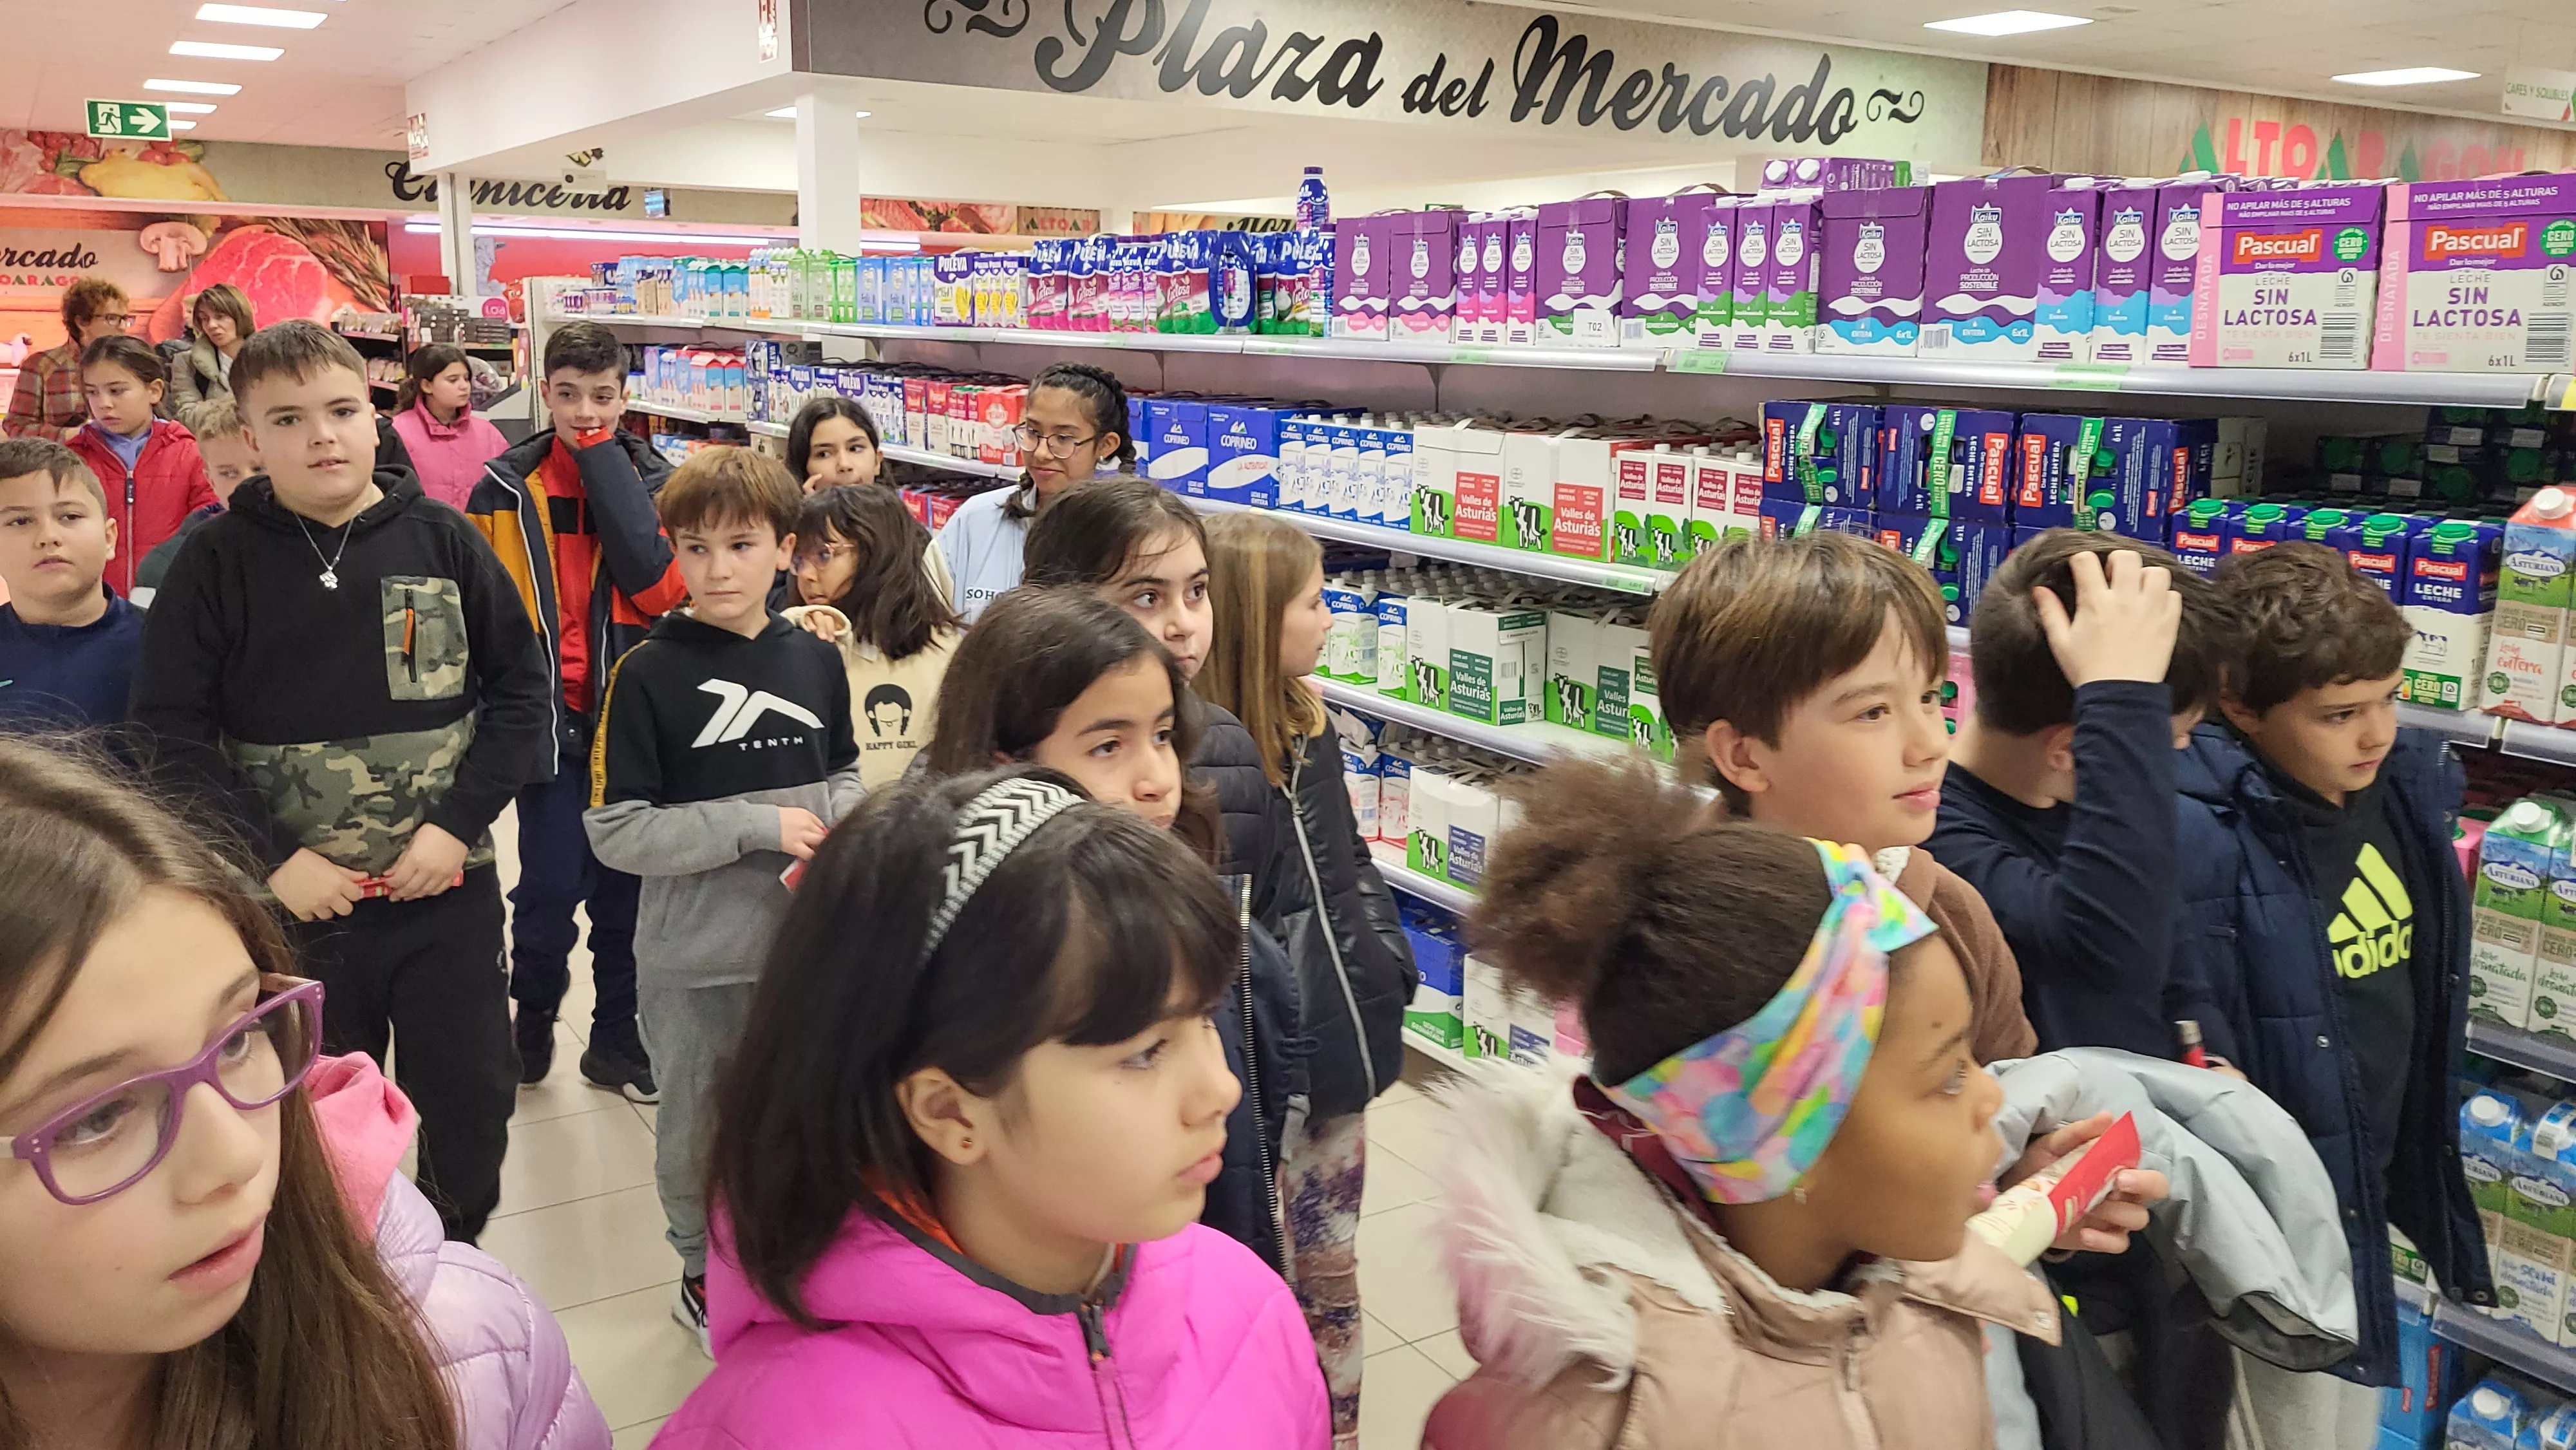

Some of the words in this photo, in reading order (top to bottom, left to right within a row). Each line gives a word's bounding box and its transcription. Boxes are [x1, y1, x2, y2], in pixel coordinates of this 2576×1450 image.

[1401, 53, 1495, 117] del
[1510, 14, 1858, 146] Mercado
[2414, 194, 2429, 203] NO
[2429, 192, 2463, 202] APILAR
[2465, 189, 2486, 200] MÁS
[2488, 189, 2502, 199] DE
[2511, 187, 2559, 198] ALTURAS
[2226, 202, 2239, 211] NO
[2240, 200, 2269, 210] APILAR
[2271, 198, 2290, 209] MÁS
[2291, 200, 2302, 209] DE
[2303, 200, 2310, 209] 5
[2310, 198, 2351, 207] ALTURAS
[1975, 213, 1999, 222] Kaiku
[2057, 214, 2081, 224] Kaiku
[2116, 214, 2141, 224] Kaiku
[2172, 211, 2197, 221] Kaiku
[1976, 227, 1993, 238] SIN
[2060, 230, 2075, 239] SIN
[2119, 229, 2135, 239] SIN
[2174, 227, 2192, 236] SIN
[2546, 231, 2574, 241] CERO
[1660, 238, 1672, 247] SIN
[1712, 239, 1723, 247] SIN
[1748, 239, 1760, 247] SIN
[1785, 237, 1796, 246] SIN
[1863, 243, 1877, 251] SIN
[1967, 239, 1999, 247] LACTOSA
[2050, 240, 2082, 248] LACTOSA
[2109, 239, 2141, 247] LACTOSA
[2164, 237, 2199, 245] LACTOSA
[2239, 233, 2320, 256] Pascual
[2429, 227, 2520, 252] Pascual
[0, 243, 99, 269] rcado
[938, 255, 967, 272] PULEVA
[2255, 276, 2291, 286] LECHE
[2450, 274, 2491, 284] LECHE
[2195, 254, 2214, 340] DESNATADA
[2253, 288, 2289, 306] SIN
[2380, 250, 2401, 343] DESNATADA
[2447, 287, 2489, 305] SIN
[2224, 308, 2318, 326] LACTOSA
[2413, 308, 2523, 327] LACTOSA
[1587, 321, 1602, 332] T02
[2226, 330, 2238, 338] TE
[2416, 332, 2430, 340] TE
[2435, 332, 2479, 341] SIENTA
[2486, 332, 2516, 340] BIEN
[2288, 351, 2313, 363] 6x1L
[2488, 355, 2517, 367] 6x1L
[838, 373, 861, 391] PULEVA
[2112, 424, 2123, 442] 6x1L
[1768, 422, 1781, 478] Pascual
[1968, 435, 1978, 463] LECHE
[2052, 440, 2061, 474] ENTERA
[1933, 457, 1946, 487] CERO
[1984, 437, 2005, 502] Pascual
[2023, 438, 2041, 502] Pascual
[1965, 465, 1975, 498] ENTERA
[2171, 451, 2186, 509] Pascual
[2049, 475, 2058, 505] LECHE
[1461, 494, 1481, 505] Valles
[1482, 496, 1492, 507] de
[1735, 493, 1761, 506] Asturia
[1455, 504, 1497, 522] Asturias
[1560, 506, 1583, 520] Valles
[1584, 509, 1595, 521] de
[1553, 517, 1601, 537] Asturias
[2179, 534, 2217, 547] Pascual
[2177, 554, 2216, 567] LECHE
[2351, 553, 2392, 569] Pascual
[2511, 557, 2561, 573] ASTURIANA
[2418, 560, 2464, 577] Pascual
[2414, 582, 2463, 599] LECHE
[1455, 670, 1476, 684] Valles
[1477, 676, 1486, 686] de
[2415, 678, 2441, 692] CERO
[1450, 680, 1492, 702] Asturias
[1604, 689, 1627, 703] Valles
[739, 735, 804, 751] TENTH
